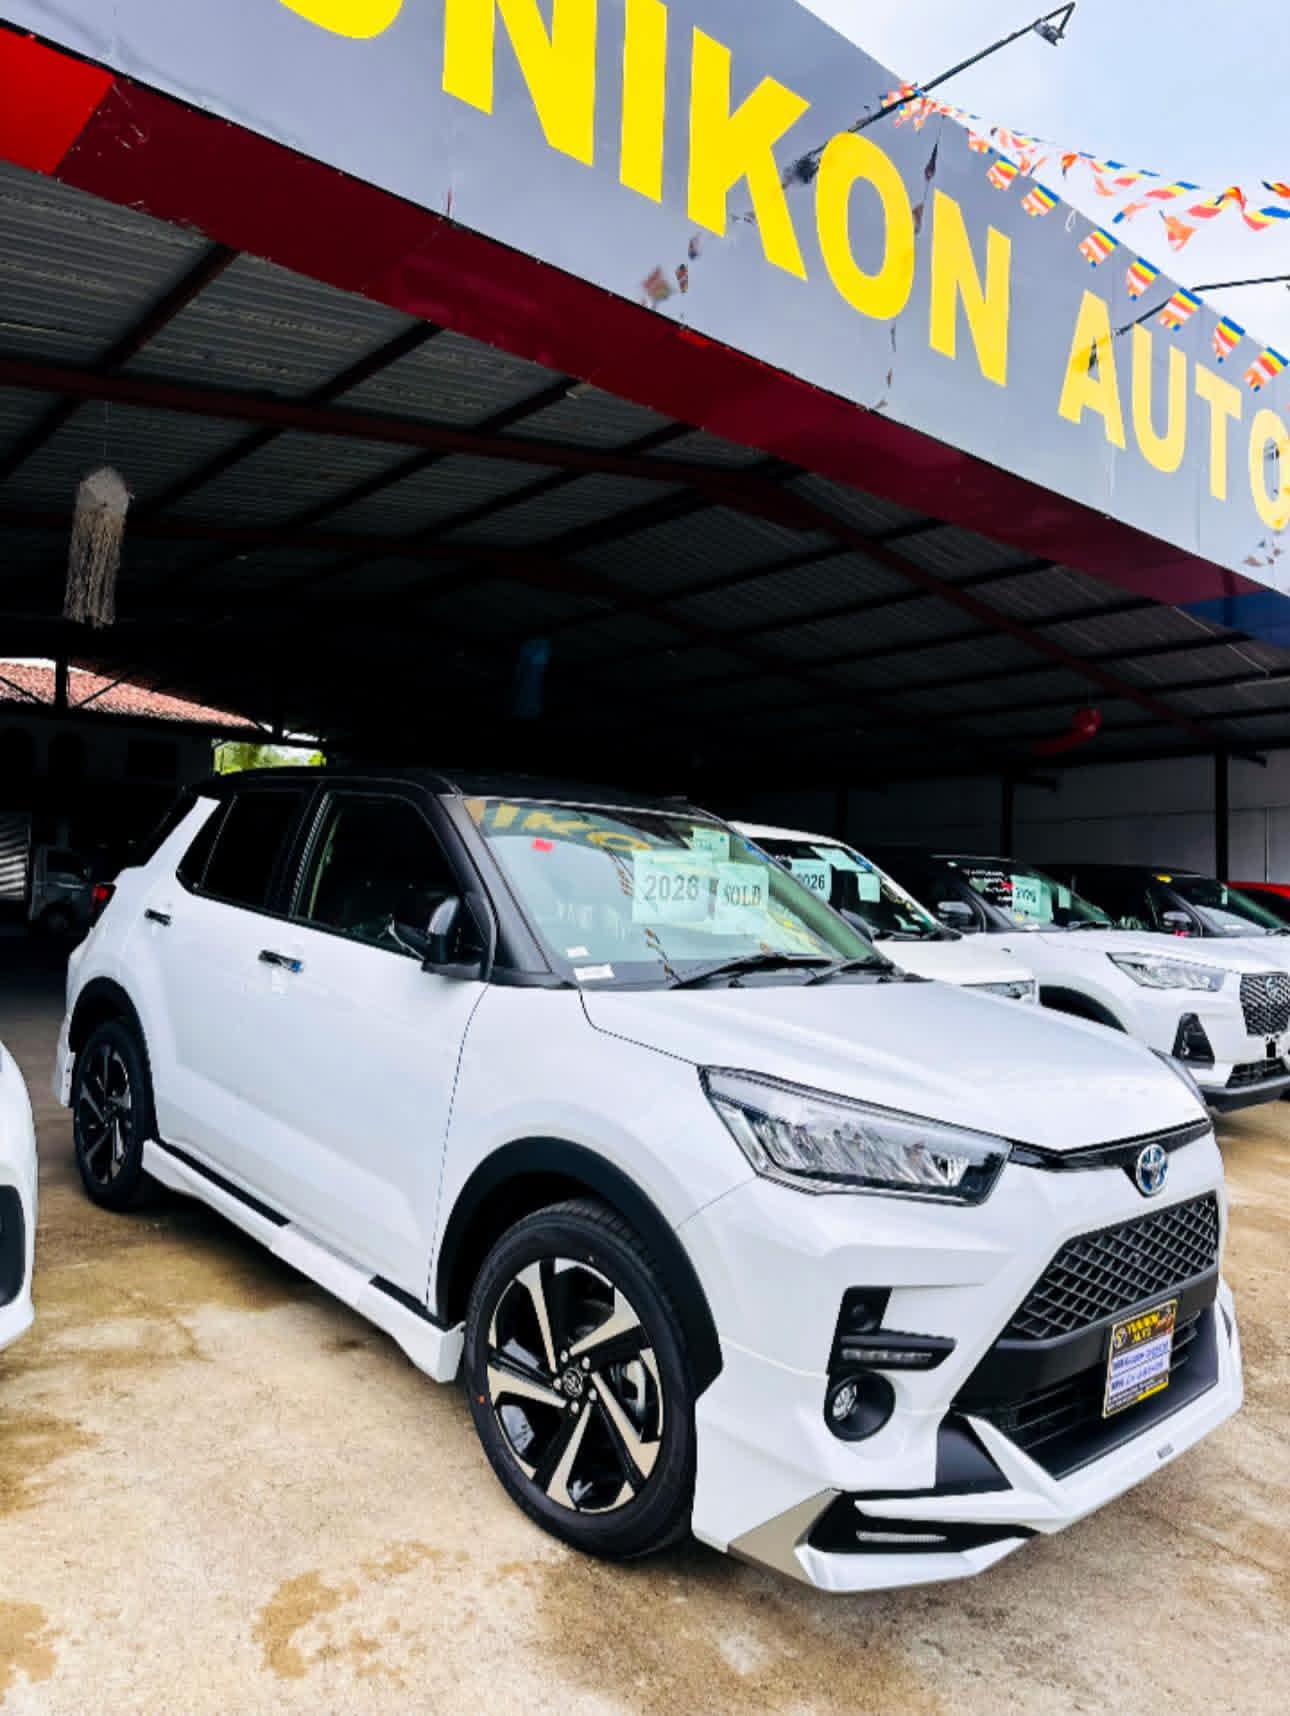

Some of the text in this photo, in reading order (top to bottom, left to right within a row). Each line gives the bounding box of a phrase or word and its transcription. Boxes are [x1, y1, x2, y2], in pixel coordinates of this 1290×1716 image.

[278, 0, 1011, 386] NIKON
[797, 873, 825, 890] 026
[724, 885, 761, 907] SOLD
